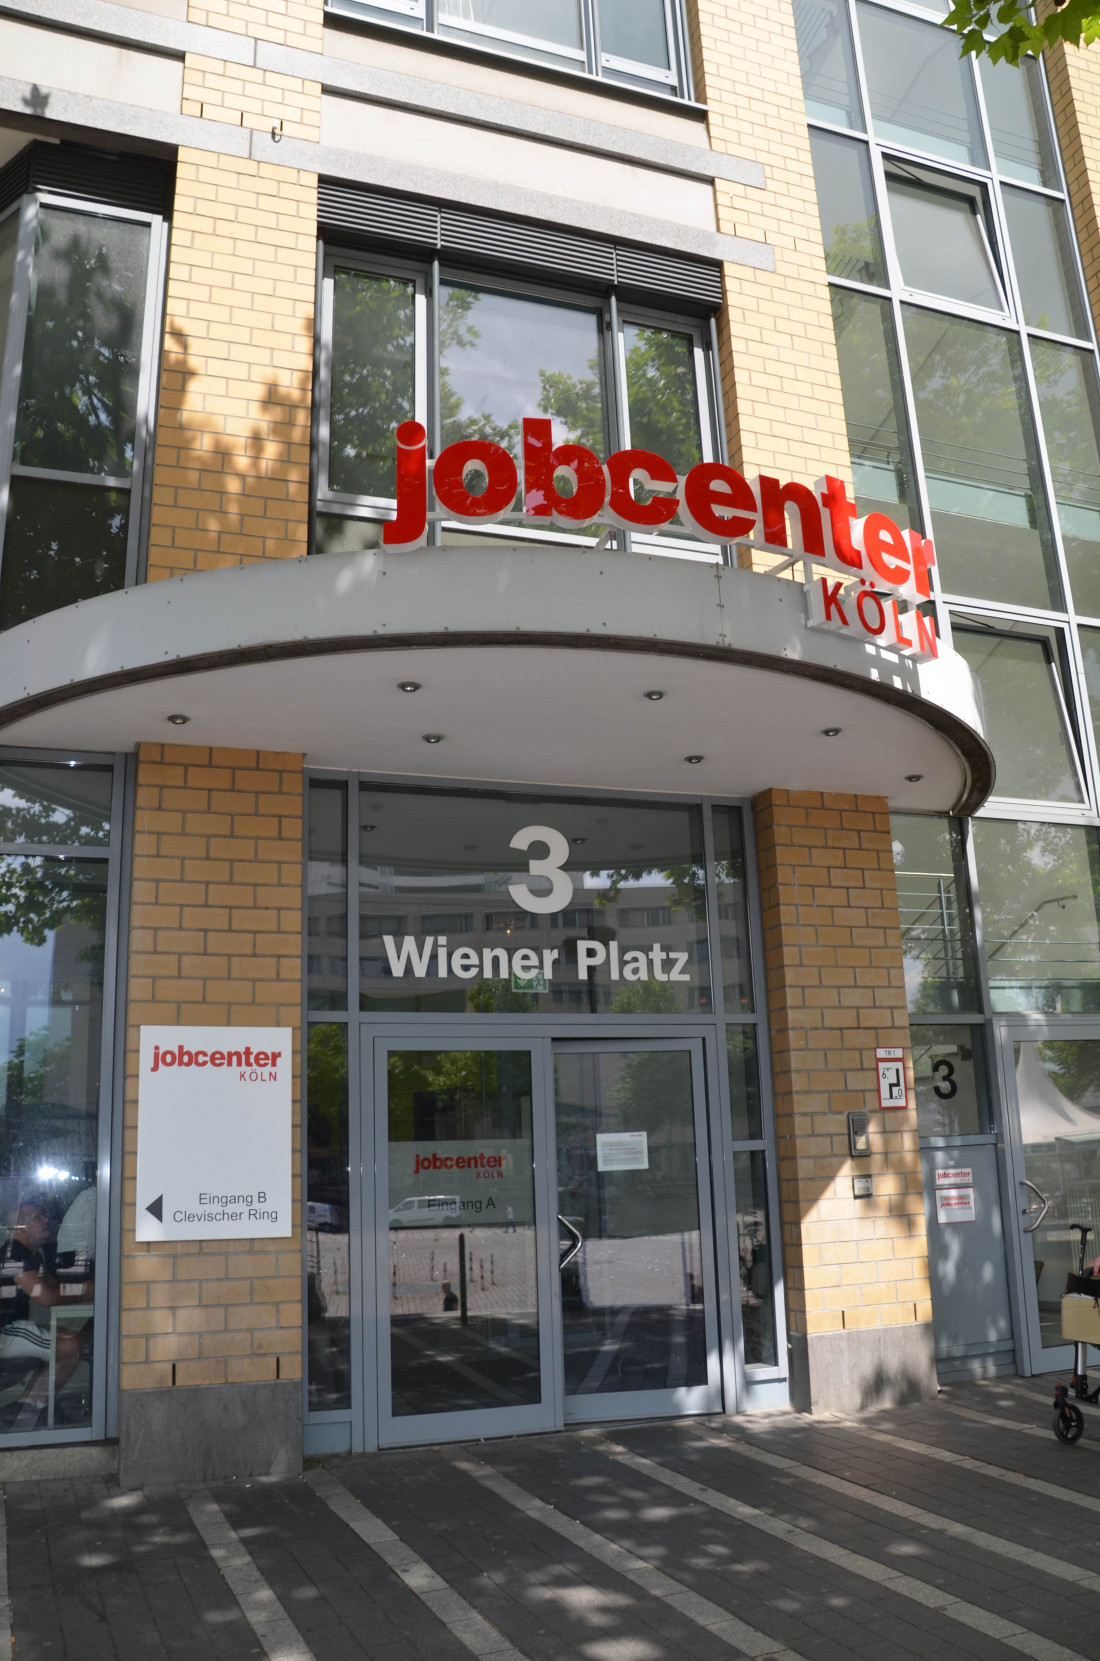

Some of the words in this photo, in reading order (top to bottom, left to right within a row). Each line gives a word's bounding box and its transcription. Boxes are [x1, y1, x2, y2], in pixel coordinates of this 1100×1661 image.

[383, 417, 937, 599] jobcenter
[819, 576, 939, 660] KÖLN
[507, 825, 574, 914] 3
[382, 934, 559, 980] Wiener
[576, 938, 691, 982] Platz
[150, 1044, 282, 1073] jobcenter
[884, 1049, 892, 1057] TR
[239, 1068, 278, 1082] KÖLN
[933, 1059, 958, 1100] 3
[413, 1151, 505, 1175] jobcenter
[476, 1168, 504, 1179] KÖLN
[937, 1170, 971, 1181] jobcenter
[199, 1192, 253, 1208] Eingang
[257, 1191, 267, 1204] B
[427, 1198, 482, 1213] Eingang
[486, 1196, 496, 1209] A
[940, 1200, 971, 1209] jobcenter
[172, 1209, 244, 1223] Clevischer
[248, 1208, 278, 1223] Ring
